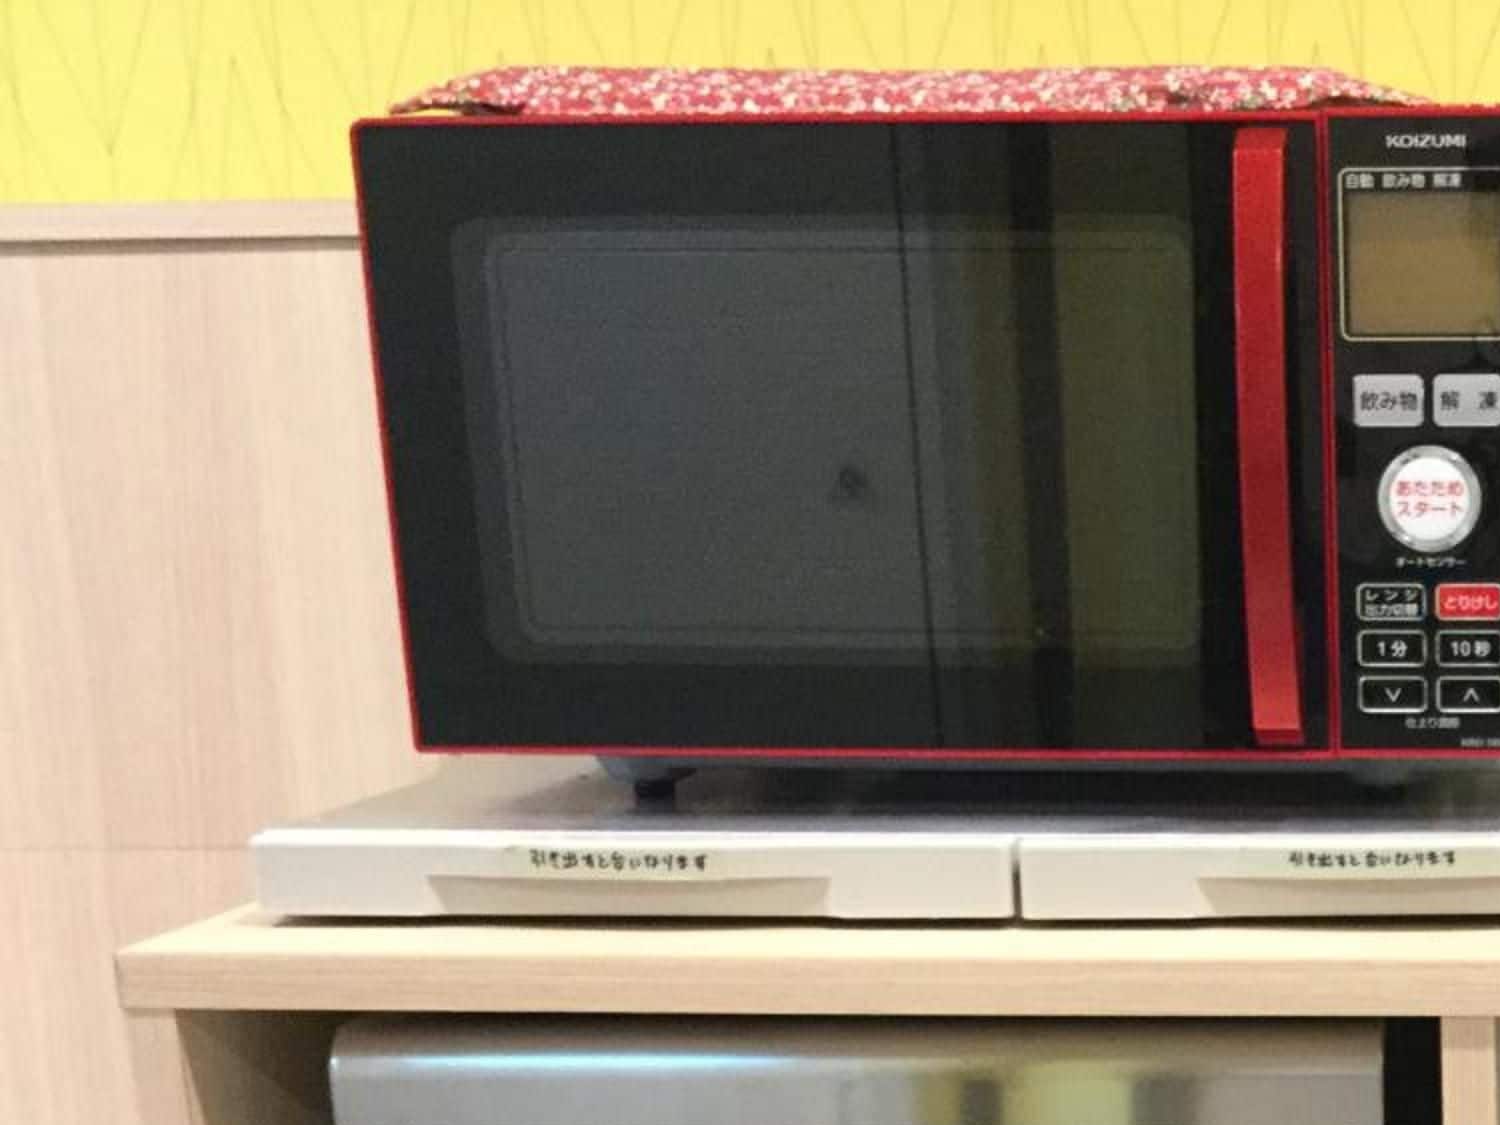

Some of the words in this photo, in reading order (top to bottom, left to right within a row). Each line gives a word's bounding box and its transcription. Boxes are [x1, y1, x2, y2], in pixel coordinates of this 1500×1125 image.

[1385, 134, 1467, 148] KOIZUMI
[1359, 391, 1418, 411] 飲み物
[1395, 479, 1465, 498] あたため
[1396, 502, 1464, 518] スタート
[1443, 592, 1498, 610] とりけし
